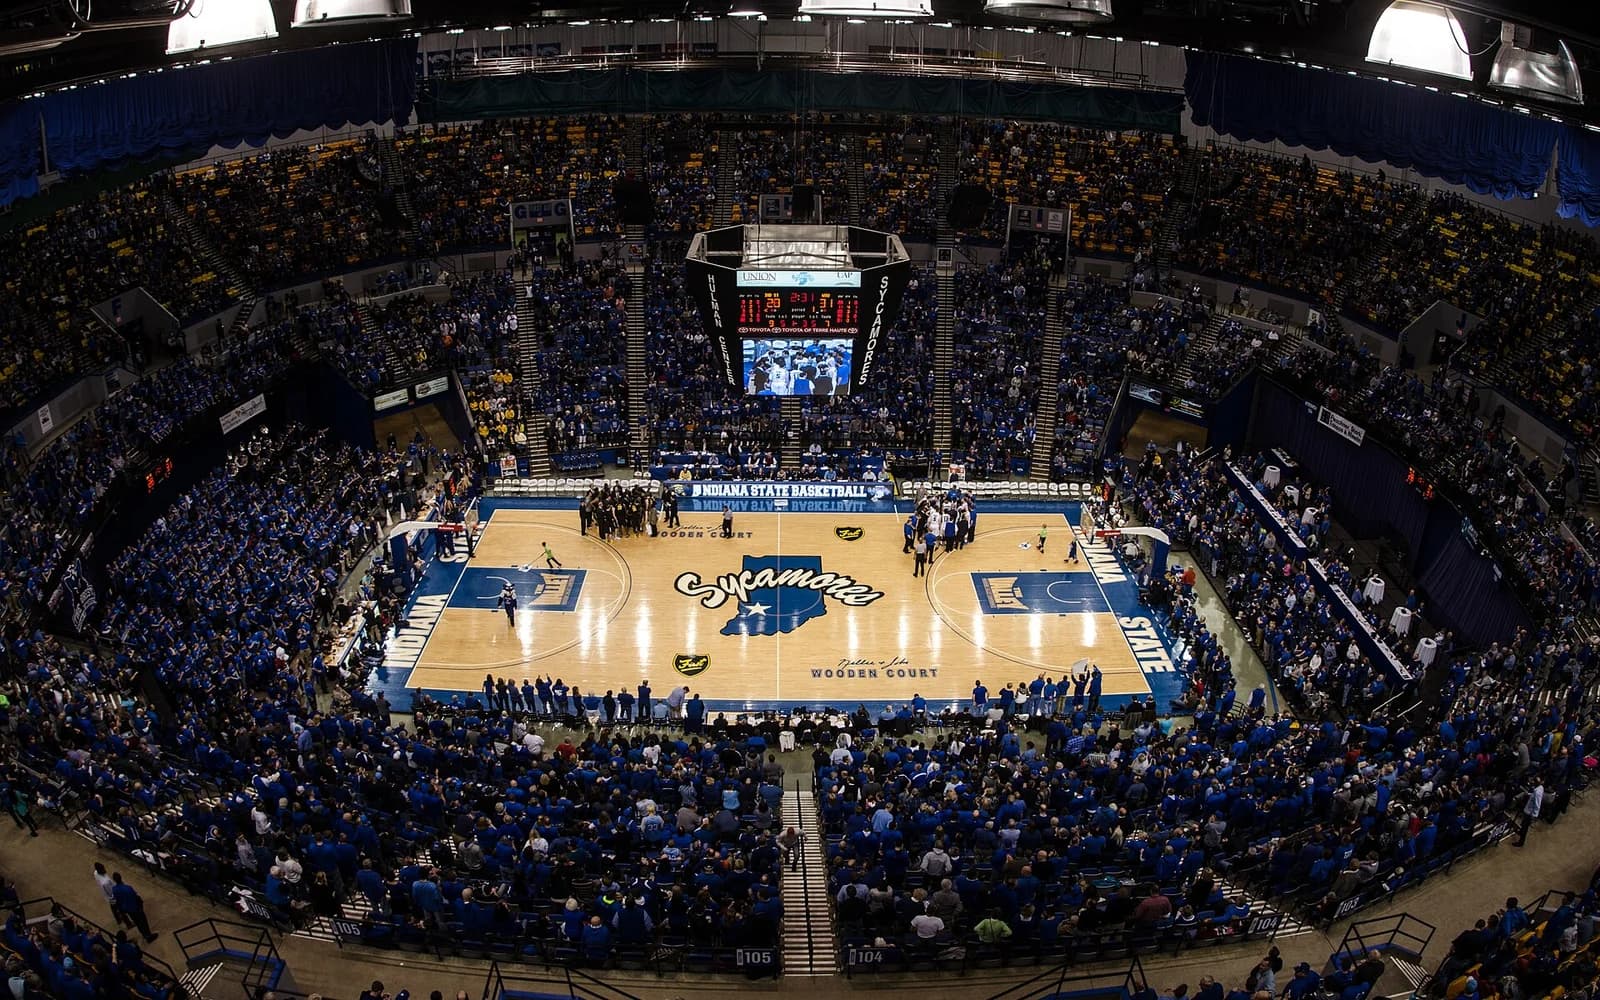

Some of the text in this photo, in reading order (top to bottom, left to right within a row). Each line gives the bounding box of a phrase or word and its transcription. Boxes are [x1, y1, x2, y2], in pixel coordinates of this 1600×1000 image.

[742, 272, 777, 281] UNION
[707, 273, 723, 328] HULMAN
[819, 298, 834, 308] 31
[858, 275, 889, 385] SYCAMORES
[692, 484, 867, 498] INDIANA STATE BASKETBALL
[674, 567, 885, 609] Sycamores
[381, 593, 450, 668] INDIANA
[1119, 616, 1177, 674] STATE
[811, 668, 938, 678] WOODEN COURT
[337, 921, 362, 936] 105
[1256, 916, 1278, 930] 104
[743, 951, 772, 964] 105
[858, 951, 883, 963] 104
